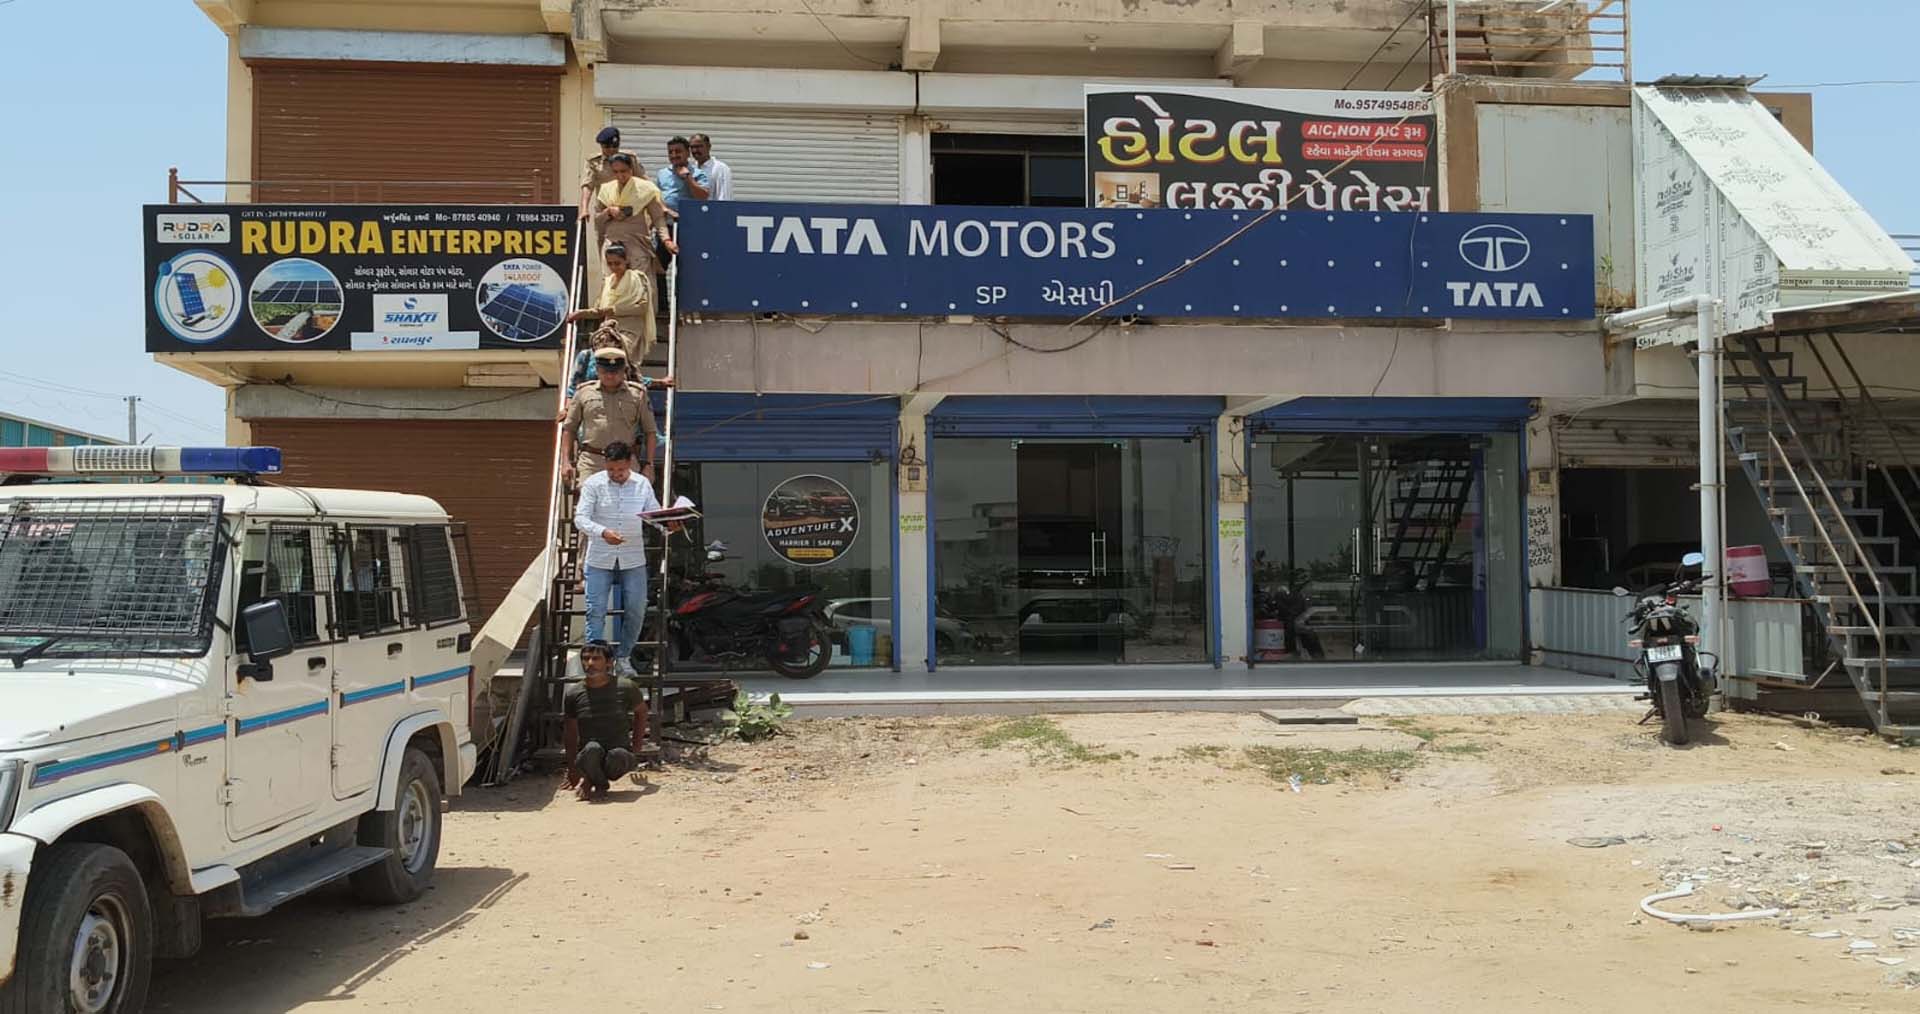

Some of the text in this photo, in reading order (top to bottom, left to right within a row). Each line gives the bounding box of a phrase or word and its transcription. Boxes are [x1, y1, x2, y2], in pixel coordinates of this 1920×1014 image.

[1096, 94, 1283, 166] હોટલ
[1299, 169, 1432, 212] પેલેસ
[162, 222, 225, 232] RUDRA
[241, 220, 568, 255] RUDRA ENTERPRISE
[735, 215, 1117, 259] TATA MOTORS
[976, 280, 1115, 306] SP એસપી
[1446, 281, 1545, 308] TATA
[384, 311, 438, 324] SHAKTI
[767, 516, 855, 538] ADVENTURE X
[817, 539, 844, 547] SAFARI
